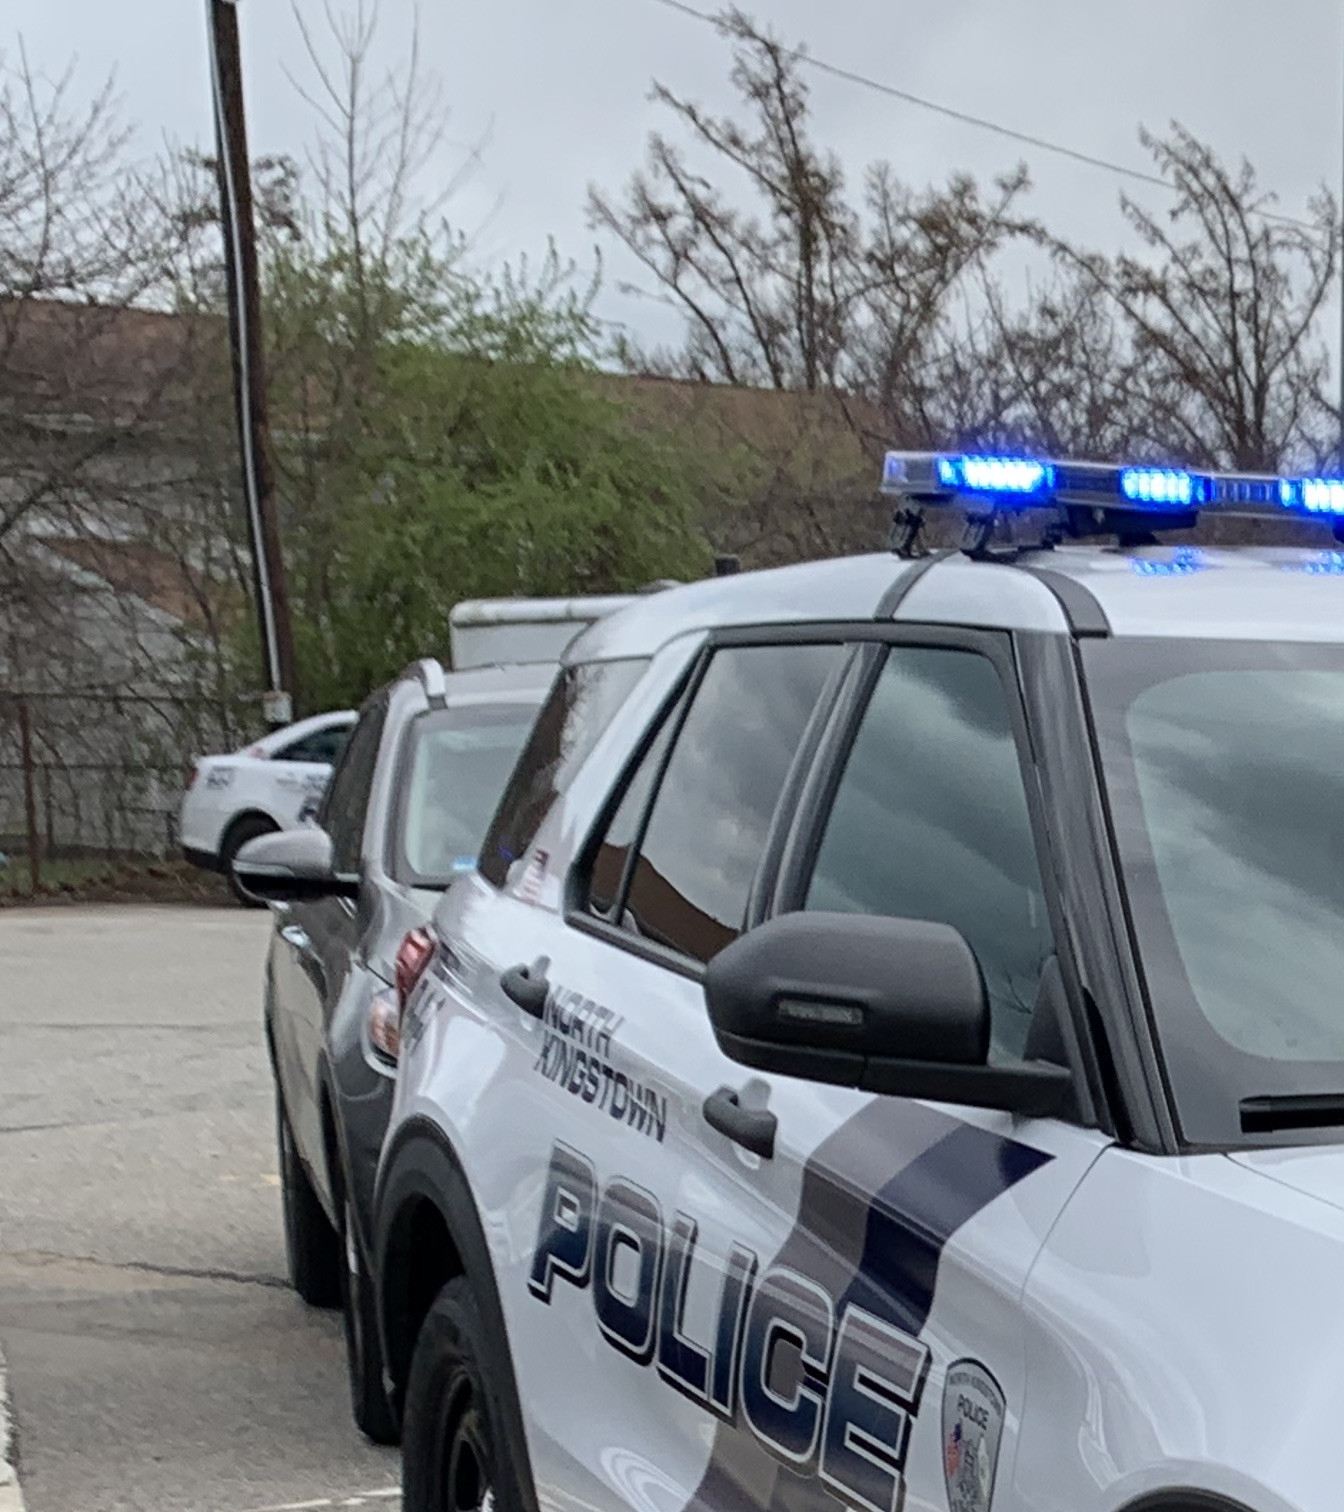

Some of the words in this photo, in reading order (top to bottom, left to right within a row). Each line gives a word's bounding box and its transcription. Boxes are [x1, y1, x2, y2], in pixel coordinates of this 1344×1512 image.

[543, 985, 626, 1060] NORTH
[533, 1030, 667, 1144] KINGSTOWN
[957, 1392, 991, 1431] POLICE
